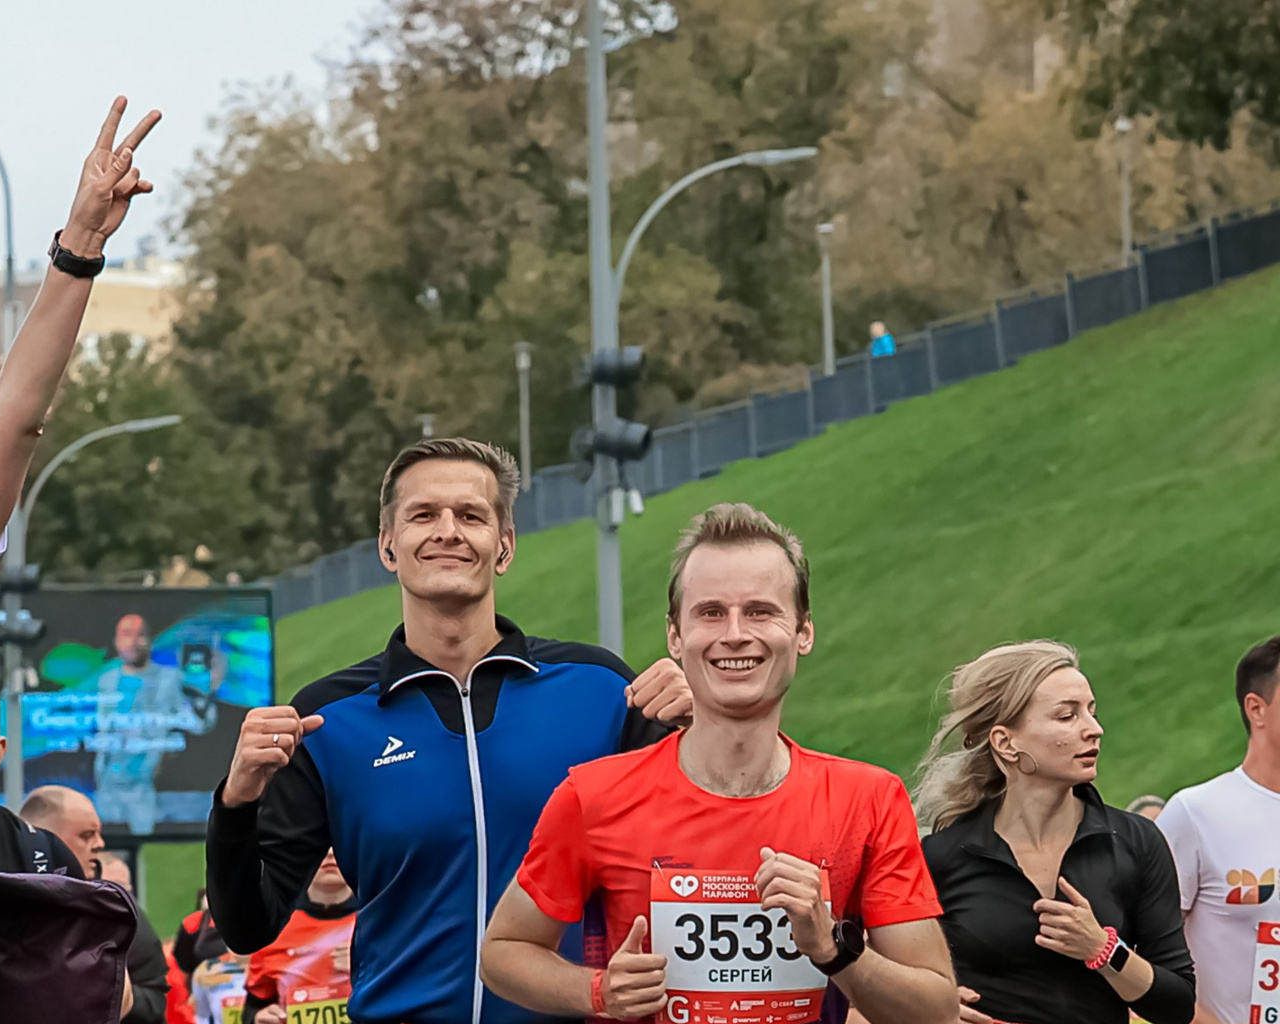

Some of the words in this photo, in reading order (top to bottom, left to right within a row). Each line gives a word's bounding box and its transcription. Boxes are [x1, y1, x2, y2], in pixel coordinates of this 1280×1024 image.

[373, 750, 417, 768] DEMIX
[701, 891, 749, 899] МАРАФОН
[674, 913, 802, 962] 3533
[708, 966, 773, 983] СЕРГЕЙ
[1258, 959, 1280, 992] 3
[667, 995, 690, 1024] G
[1264, 1006, 1278, 1024] G
